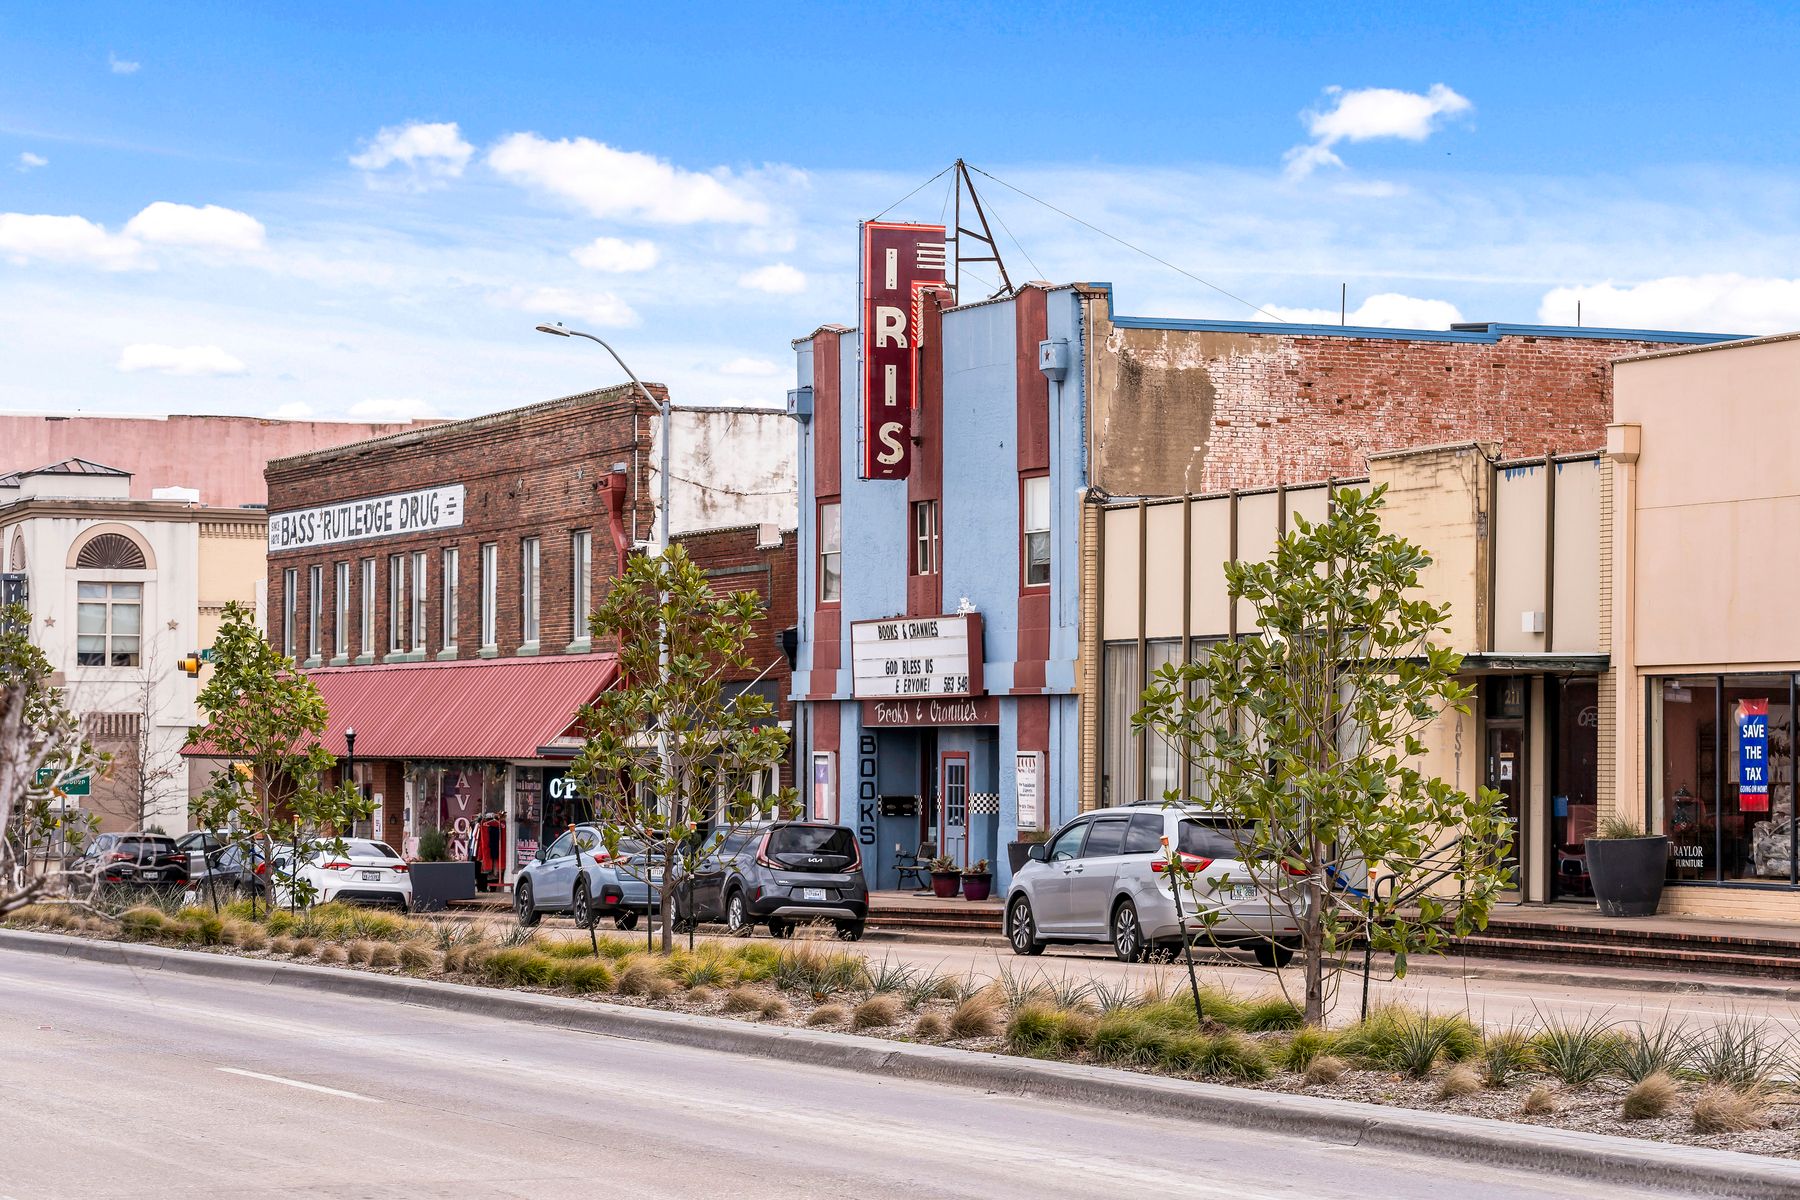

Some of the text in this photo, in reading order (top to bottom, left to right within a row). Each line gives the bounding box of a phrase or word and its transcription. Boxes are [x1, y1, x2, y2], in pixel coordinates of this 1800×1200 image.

[875, 247, 907, 466] IRIS
[400, 492, 439, 529] DRUG
[878, 621, 939, 640] BOOKS & CRANNIES
[885, 659, 934, 675] GOD BLESS US
[1504, 690, 1520, 705] 211
[875, 702, 908, 724] Books
[930, 699, 979, 723] Crannies
[1578, 709, 1598, 728] OPE
[1742, 724, 1765, 738] SAVE
[1745, 746, 1762, 759] THE
[1745, 767, 1762, 780] TAX
[549, 778, 577, 799] OP
[859, 735, 876, 845] BOOKS
[454, 771, 471, 861] AVON
[1667, 841, 1703, 857] TRAYLOR
[1675, 860, 1704, 868] FURNITURE
